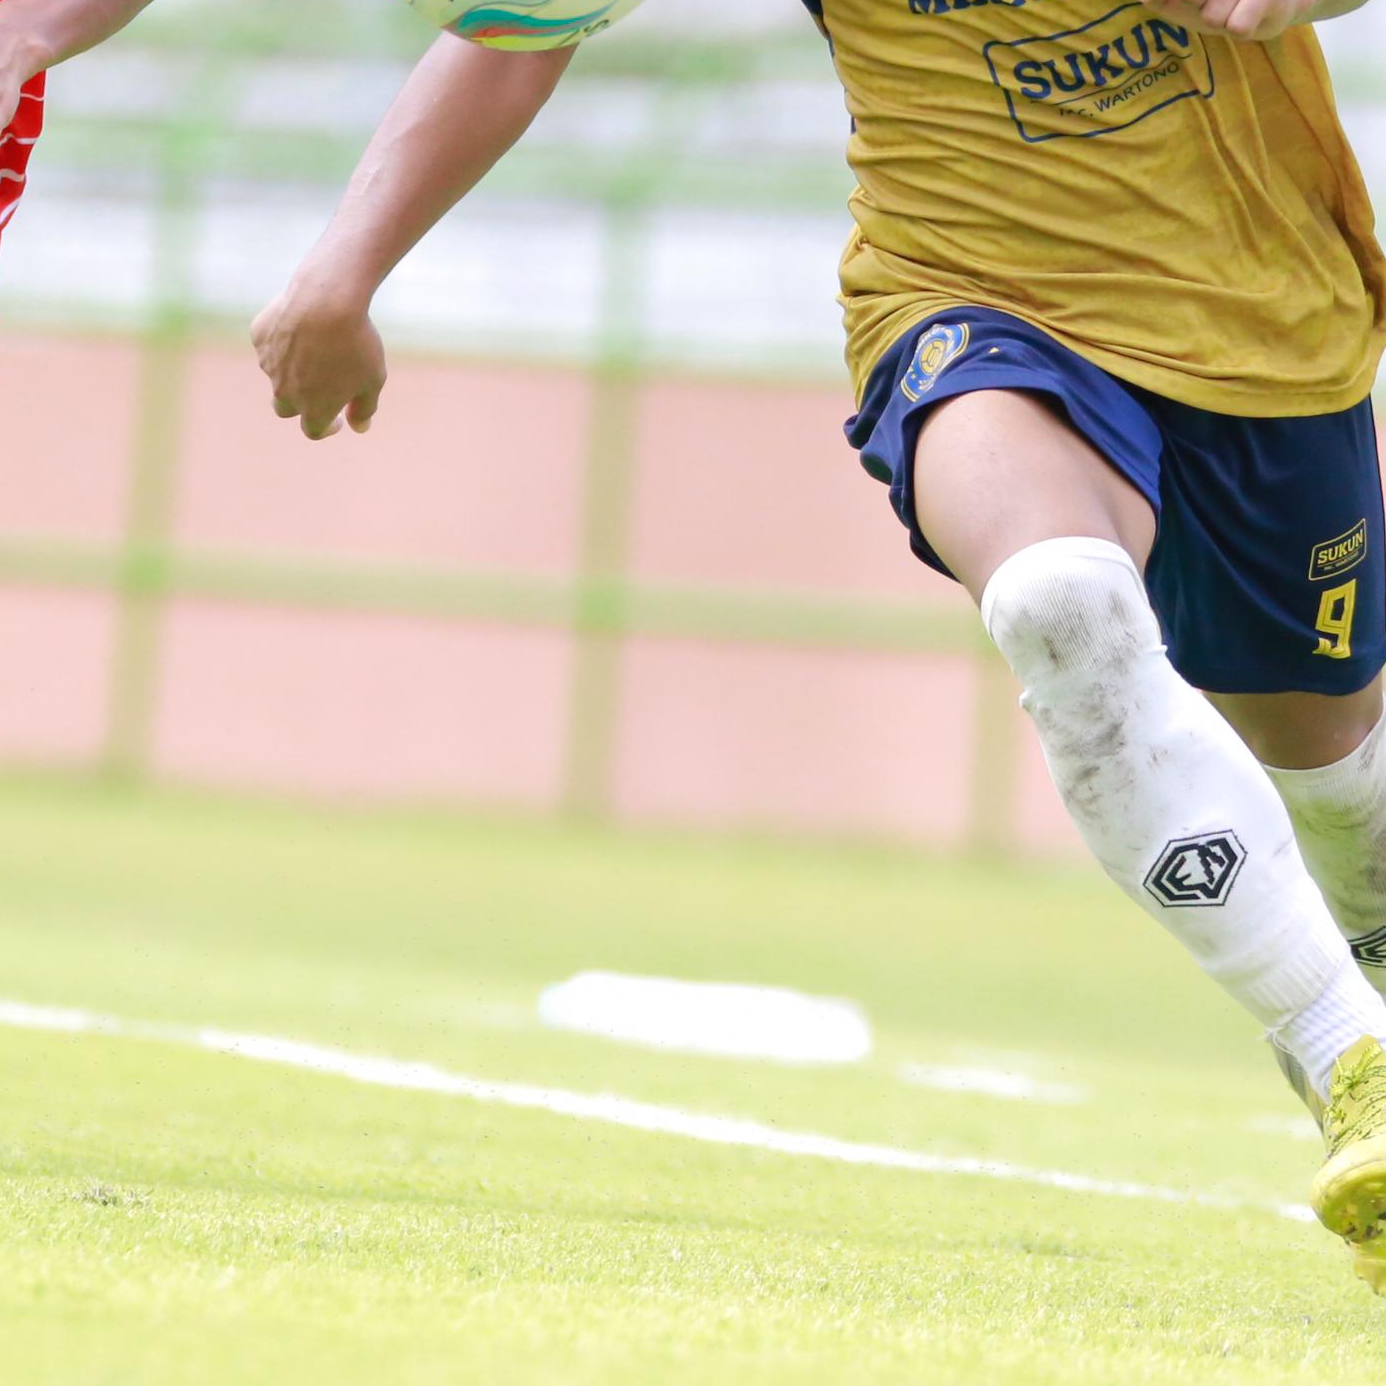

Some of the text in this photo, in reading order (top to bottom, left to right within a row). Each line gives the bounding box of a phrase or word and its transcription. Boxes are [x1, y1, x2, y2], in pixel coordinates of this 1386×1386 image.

[1014, 19, 1190, 99] SUKUN
[1094, 62, 1180, 113] WARTONO
[1317, 529, 1364, 565] SUKUN
[1313, 578, 1357, 659] 9
